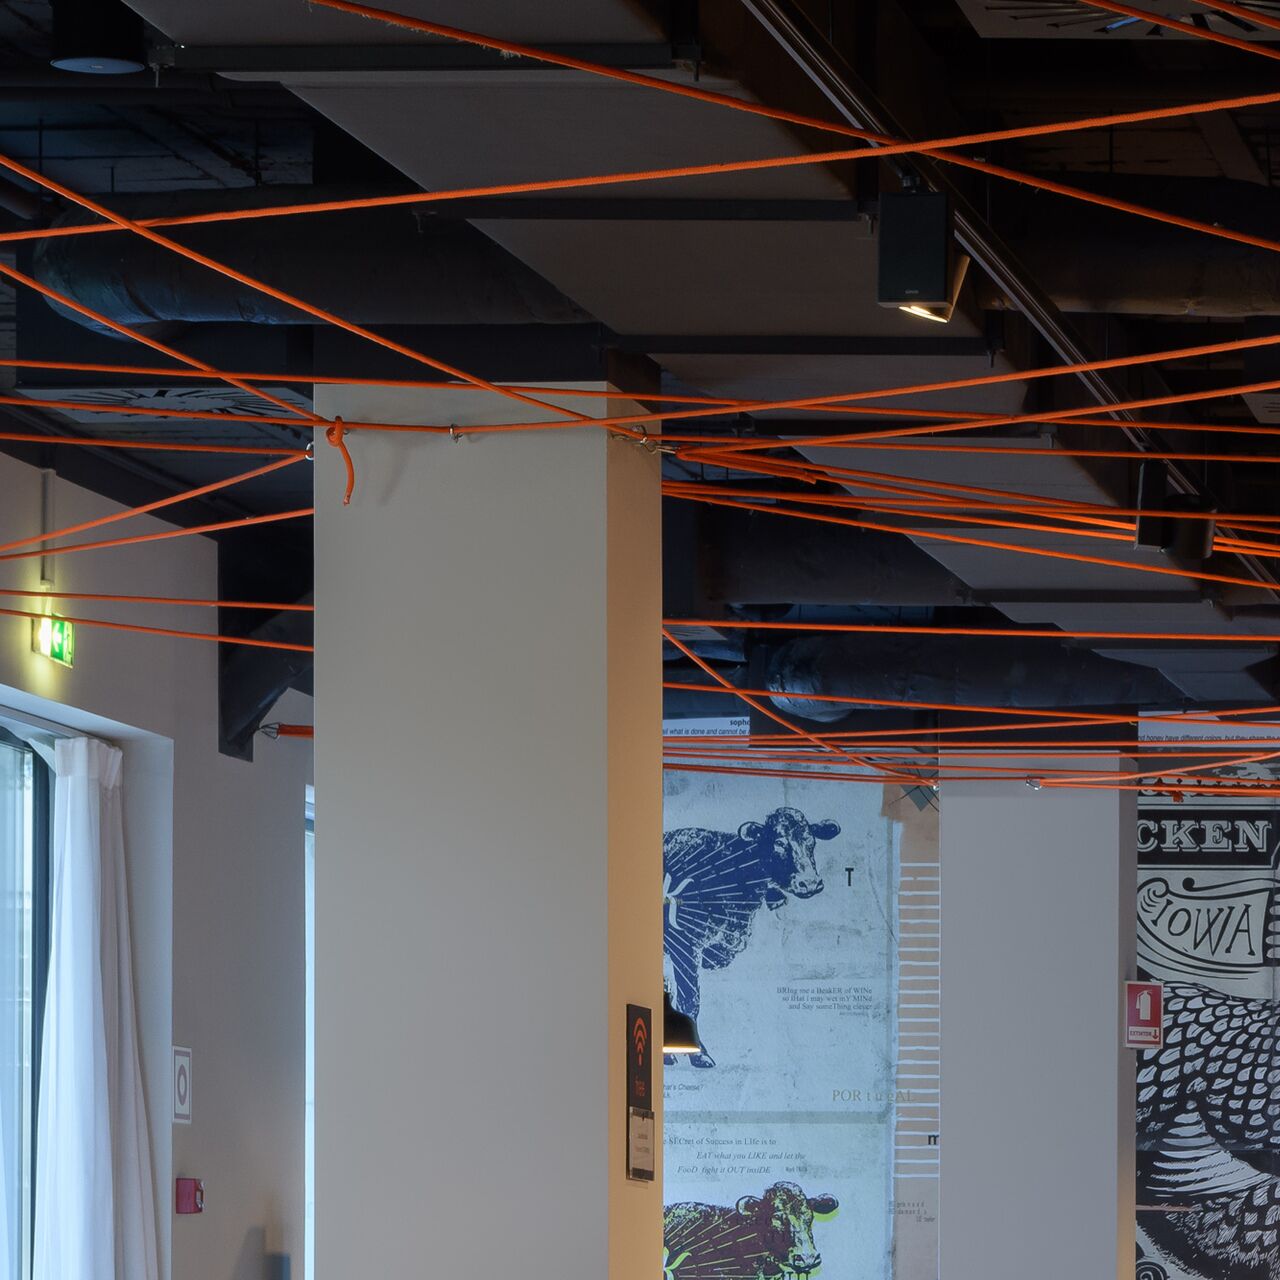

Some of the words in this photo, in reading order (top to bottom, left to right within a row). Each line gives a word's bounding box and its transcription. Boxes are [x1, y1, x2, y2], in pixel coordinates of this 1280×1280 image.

[1150, 899, 1256, 957] IOWA
[696, 1151, 714, 1160] EAT
[714, 1151, 731, 1160] what
[732, 1152, 746, 1161] you
[748, 1151, 768, 1160] LIKE
[769, 1151, 783, 1160] and
